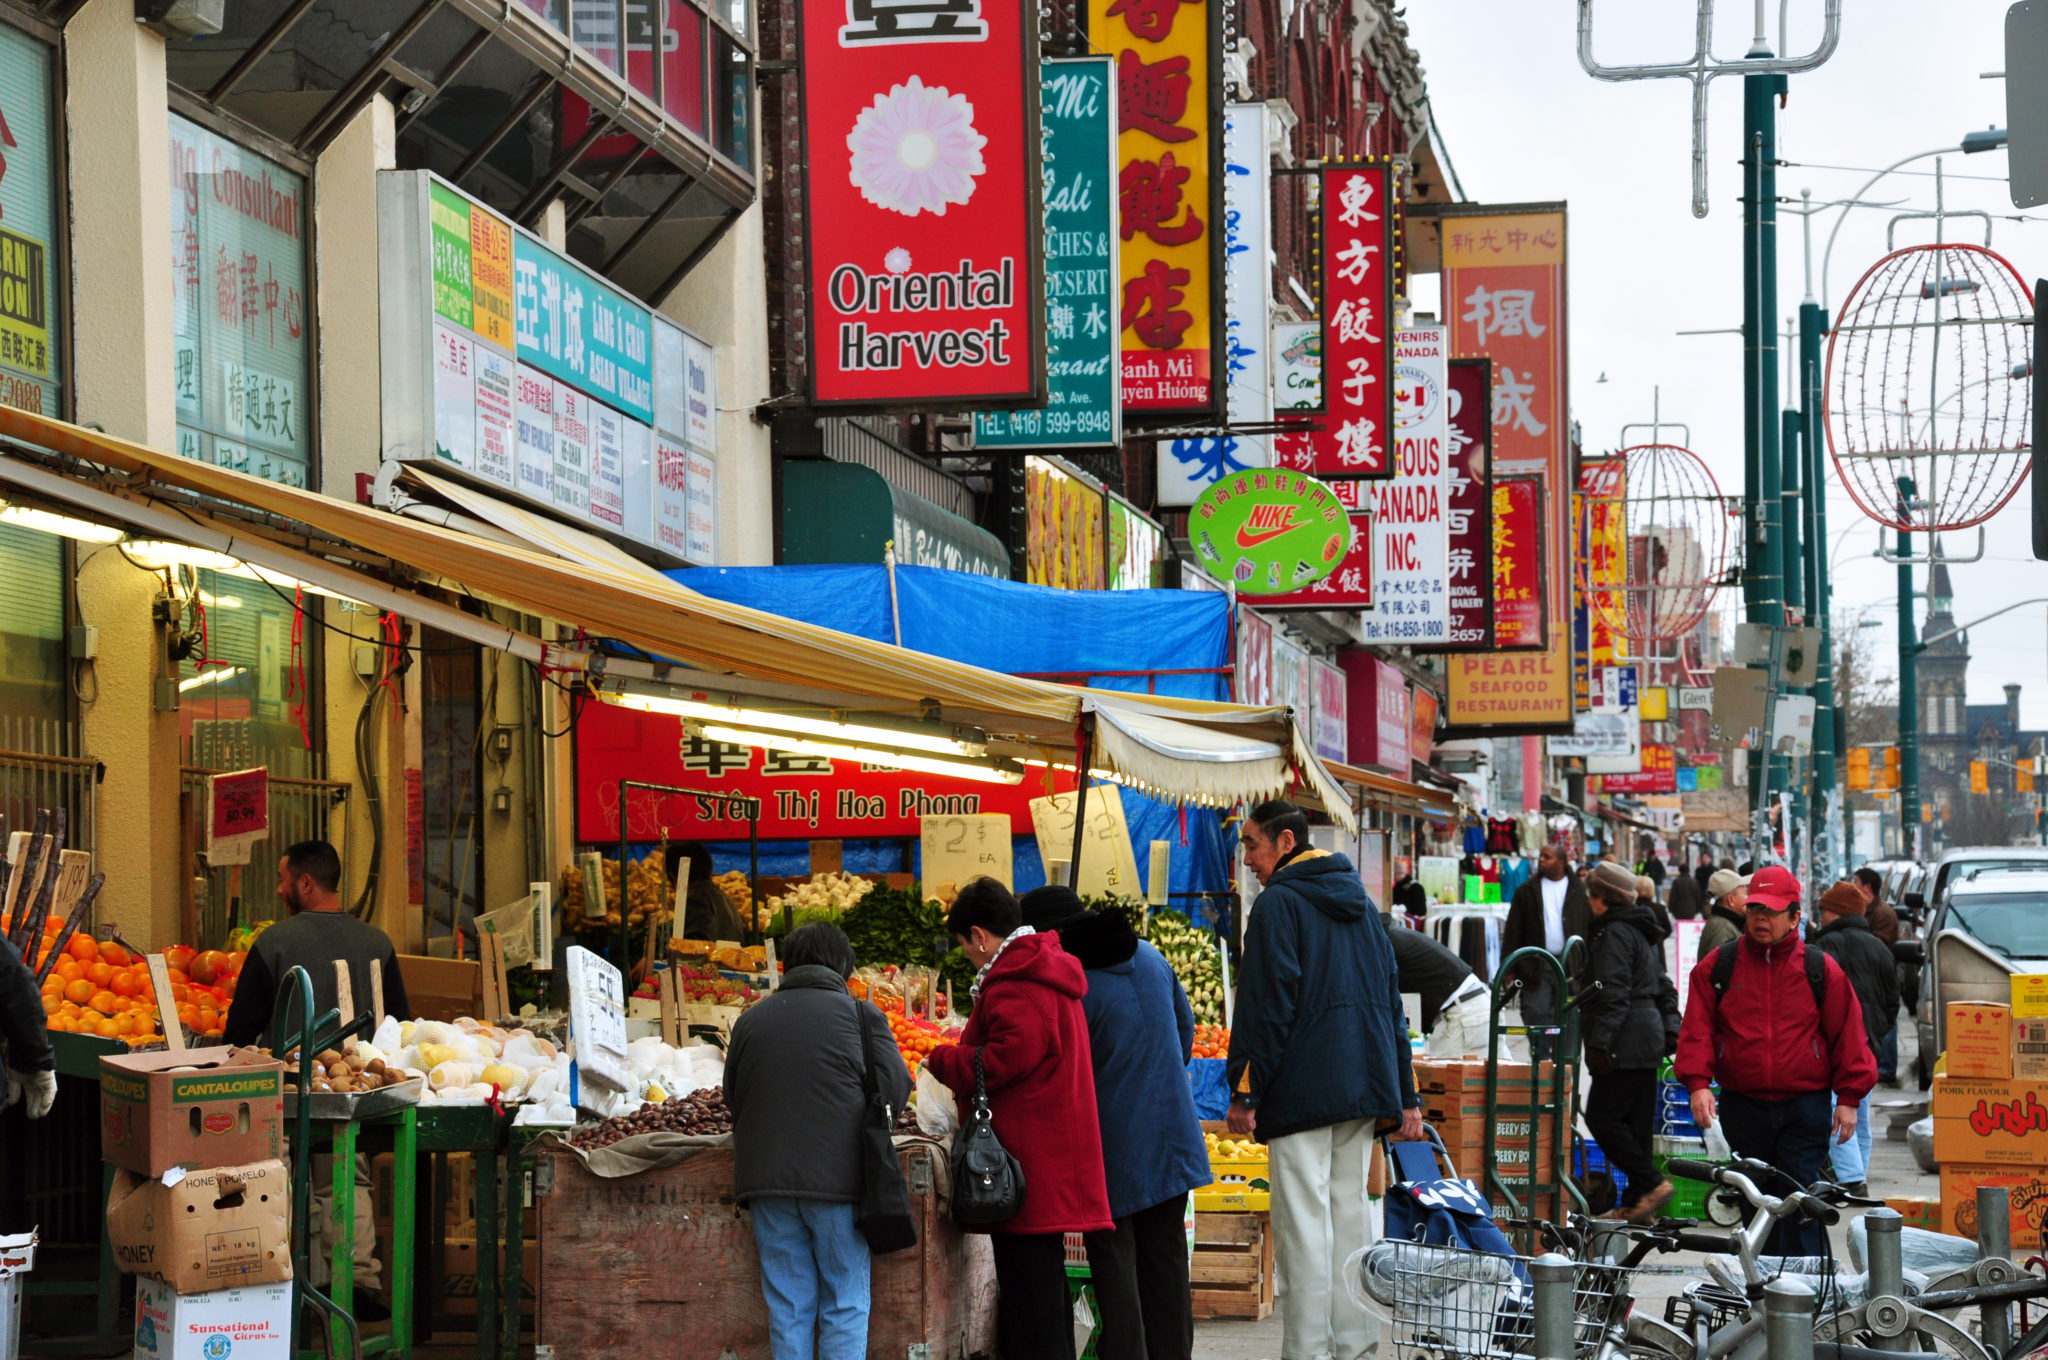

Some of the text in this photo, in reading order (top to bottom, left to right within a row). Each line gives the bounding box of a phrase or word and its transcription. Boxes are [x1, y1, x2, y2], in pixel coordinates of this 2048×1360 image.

[212, 148, 299, 240] Consultant
[1097, 232, 1109, 256] &
[1450, 229, 1559, 253] 新光中心
[217, 243, 302, 349] 翻譯中心
[829, 258, 1014, 313] Oriental
[515, 257, 585, 375] 亞洲城
[1050, 302, 1107, 340] 糖水
[1331, 174, 1382, 468] 東方餃子樓
[1, 328, 46, 371] 西联汇款
[840, 319, 1010, 371] Harvest
[175, 349, 196, 400] 理
[1166, 355, 1194, 377] Mì
[590, 351, 651, 414] ASIAN VILLAGE
[229, 363, 295, 441] 精通英文
[1069, 391, 1093, 404] Ave.
[978, 414, 1005, 436] TEL:
[1046, 411, 1111, 434] 599-8948
[1199, 473, 1341, 524] 時尚運動鞋專門店
[1247, 504, 1301, 528] NIKE
[1201, 531, 1223, 565] Reebok
[1386, 533, 1422, 571] INC.
[1373, 579, 1443, 594] 拿大紀念品
[1379, 600, 1431, 616] 有限公司
[1452, 598, 1484, 608] BAKERY
[1366, 619, 1443, 638] Tel: 416-850-1800
[1450, 629, 1485, 641] 2657
[1464, 658, 1554, 675] PEARL
[1470, 681, 1548, 693] SEAFOOD
[1684, 692, 1706, 705] Glen
[1456, 698, 1563, 712] RESTAURANT
[774, 789, 820, 828] Thị
[837, 789, 886, 819] Hoa
[900, 788, 980, 816] Phong
[945, 817, 967, 853] 2
[979, 854, 996, 864] EA
[177, 1079, 275, 1096] CANTALOUPES
[1940, 1087, 2010, 1096] PORK FLAVOUR
[1496, 1122, 1519, 1136] BERRY
[1495, 1149, 1518, 1163] BERRY
[185, 1168, 266, 1189] HONEY POMELO
[188, 1321, 270, 1334] Sunsational
[234, 1333, 266, 1341] Citrus
